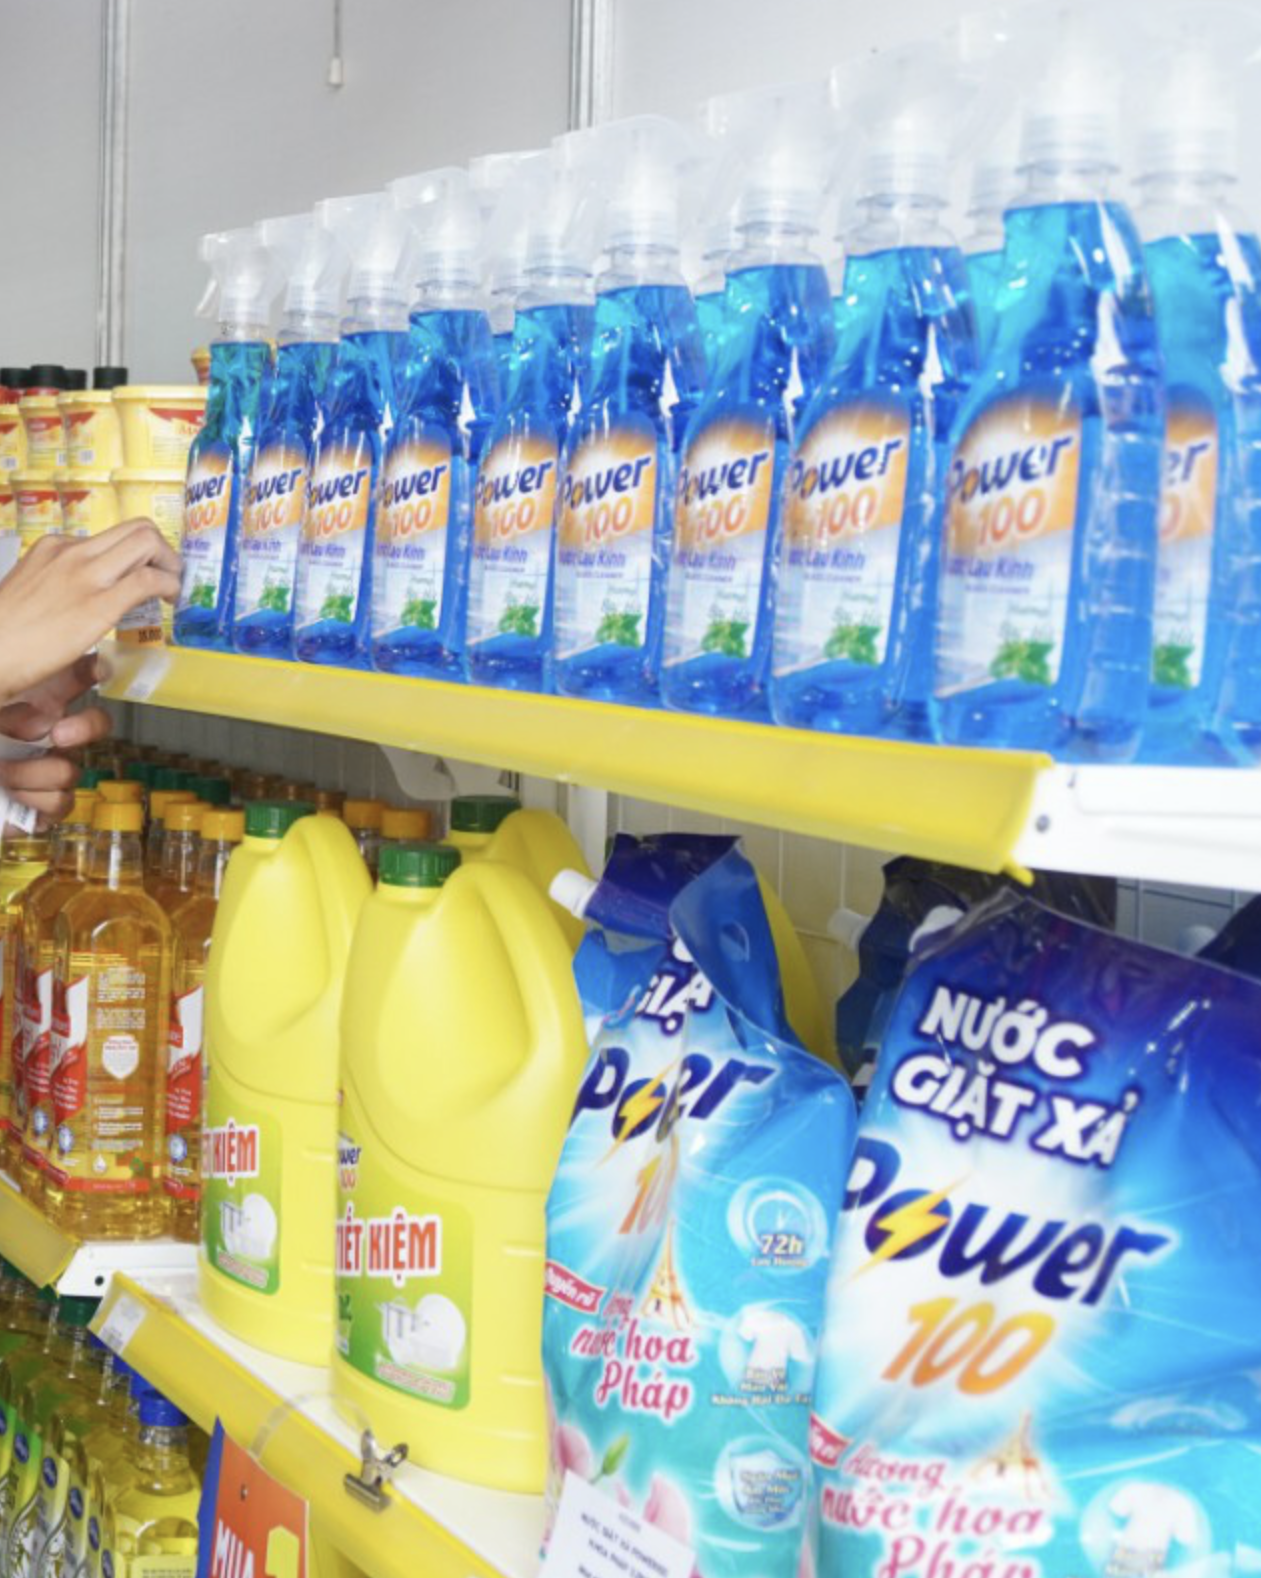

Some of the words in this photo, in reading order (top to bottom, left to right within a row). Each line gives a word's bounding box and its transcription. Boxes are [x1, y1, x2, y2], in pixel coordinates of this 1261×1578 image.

[791, 439, 902, 500] Power
[946, 436, 1072, 504] Power
[316, 501, 351, 537] 100
[392, 499, 431, 537] 100
[492, 497, 536, 538] 100
[585, 497, 633, 542] 100
[697, 494, 745, 542] 100
[816, 487, 878, 540] 100
[978, 488, 1046, 546] 100
[920, 986, 1096, 1078] NƯỚC
[892, 1054, 1036, 1137] GIẶT
[1034, 1092, 1138, 1165] XẢ
[212, 1121, 257, 1183] KIỆM
[368, 1213, 437, 1282] KIỆM
[761, 1233, 803, 1254] 72h
[841, 1135, 1171, 1306] Power
[625, 1318, 694, 1363] hoa
[881, 1297, 1056, 1395] 100
[596, 1360, 690, 1419] Pháp
